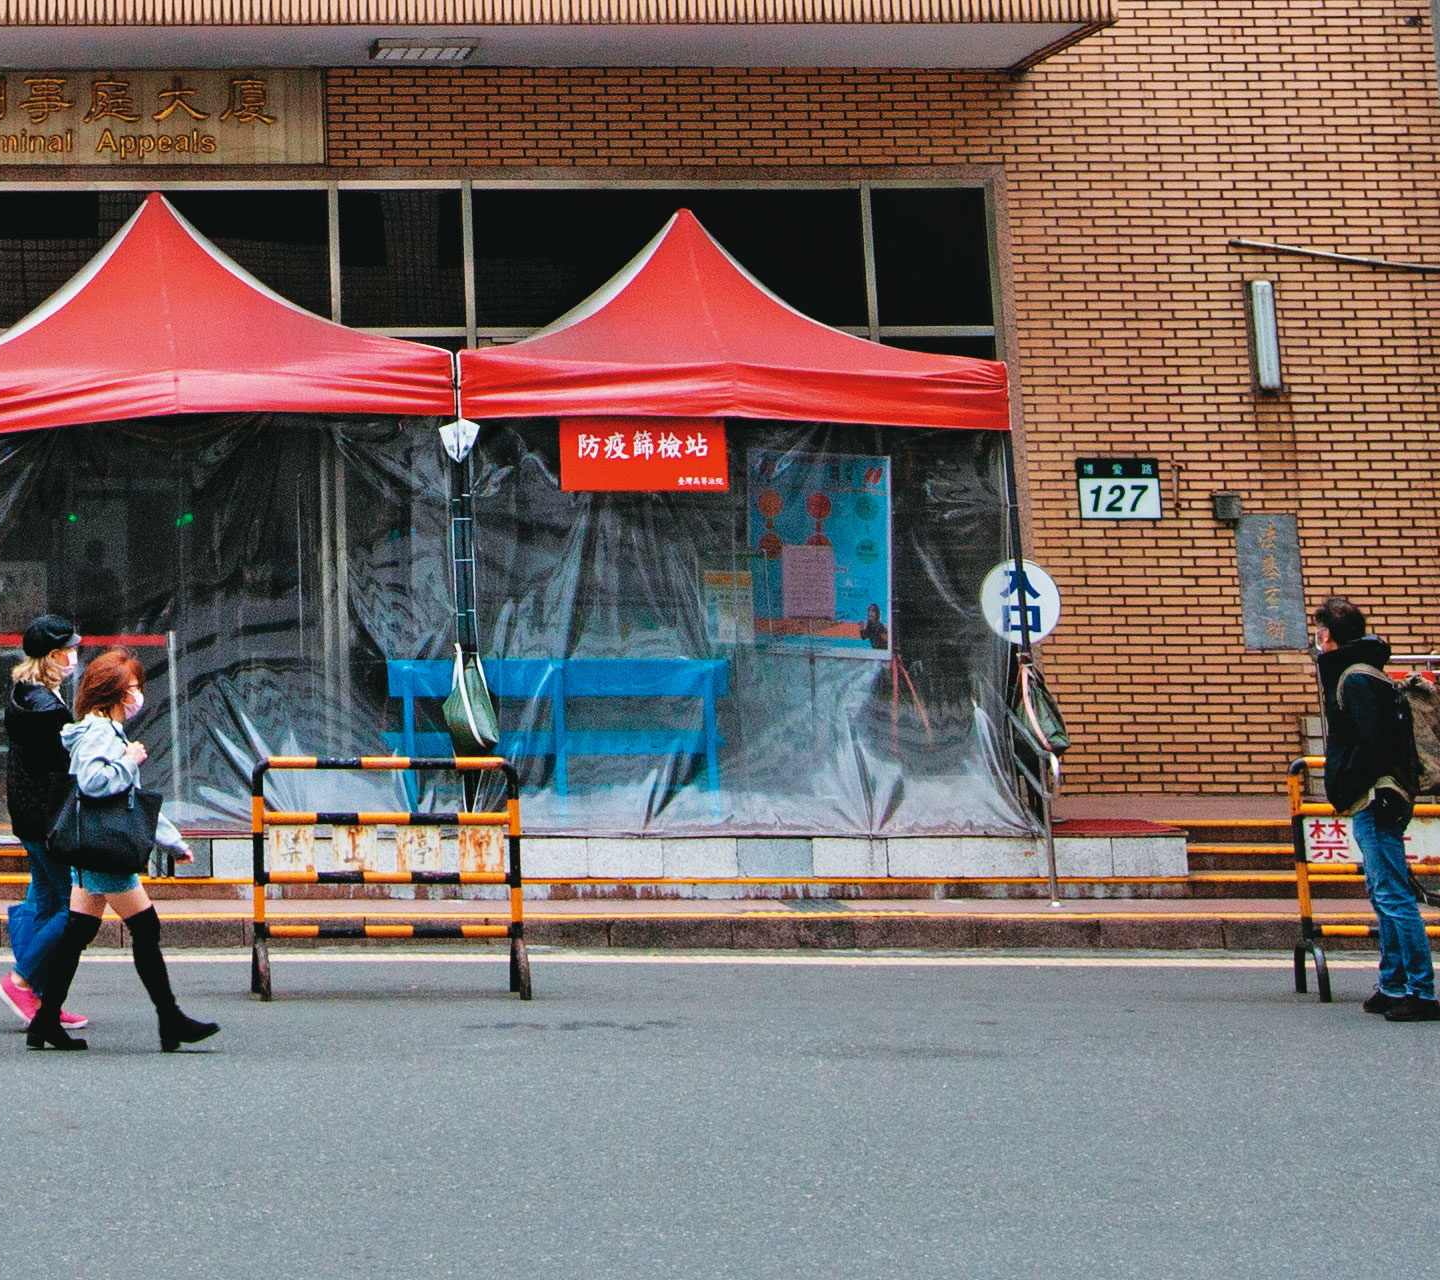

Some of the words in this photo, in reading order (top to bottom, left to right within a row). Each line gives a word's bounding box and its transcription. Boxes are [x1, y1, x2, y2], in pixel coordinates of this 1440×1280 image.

[96, 130, 217, 159] Appeals
[577, 430, 708, 461] 防疫篩檢站
[1090, 485, 1148, 512] 127
[1000, 571, 1041, 632] 入口
